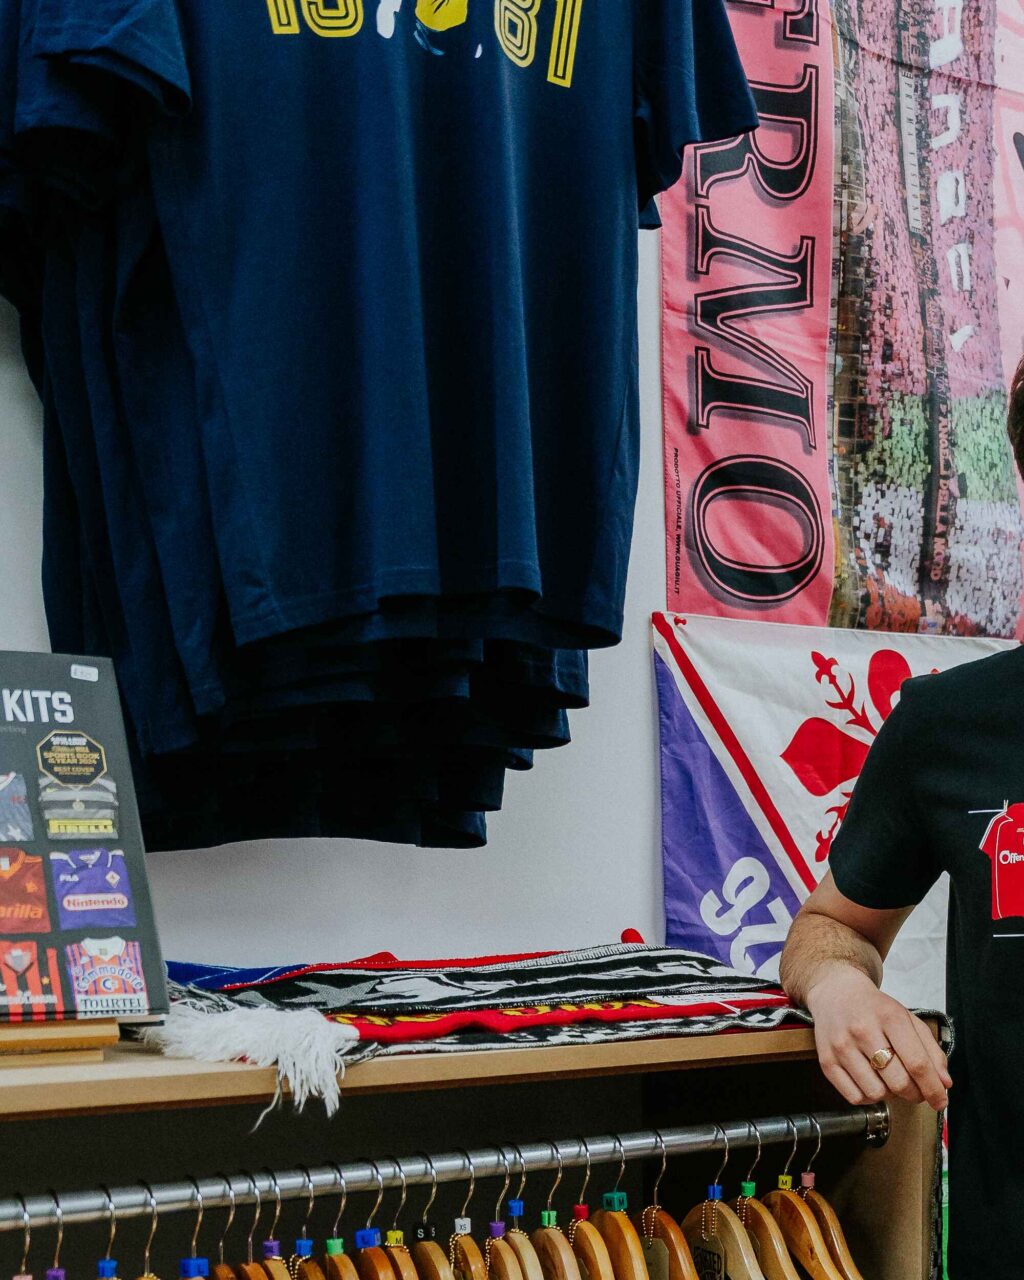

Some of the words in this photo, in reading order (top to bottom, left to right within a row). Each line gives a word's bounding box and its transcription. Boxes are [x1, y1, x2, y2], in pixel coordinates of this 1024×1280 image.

[693, 0, 824, 604] RMO
[2, 689, 75, 724] KITS
[66, 897, 126, 908] Nintendo
[76, 965, 144, 991] Commodore
[81, 998, 144, 1010] TOURTEL
[417, 1228, 424, 1238] S
